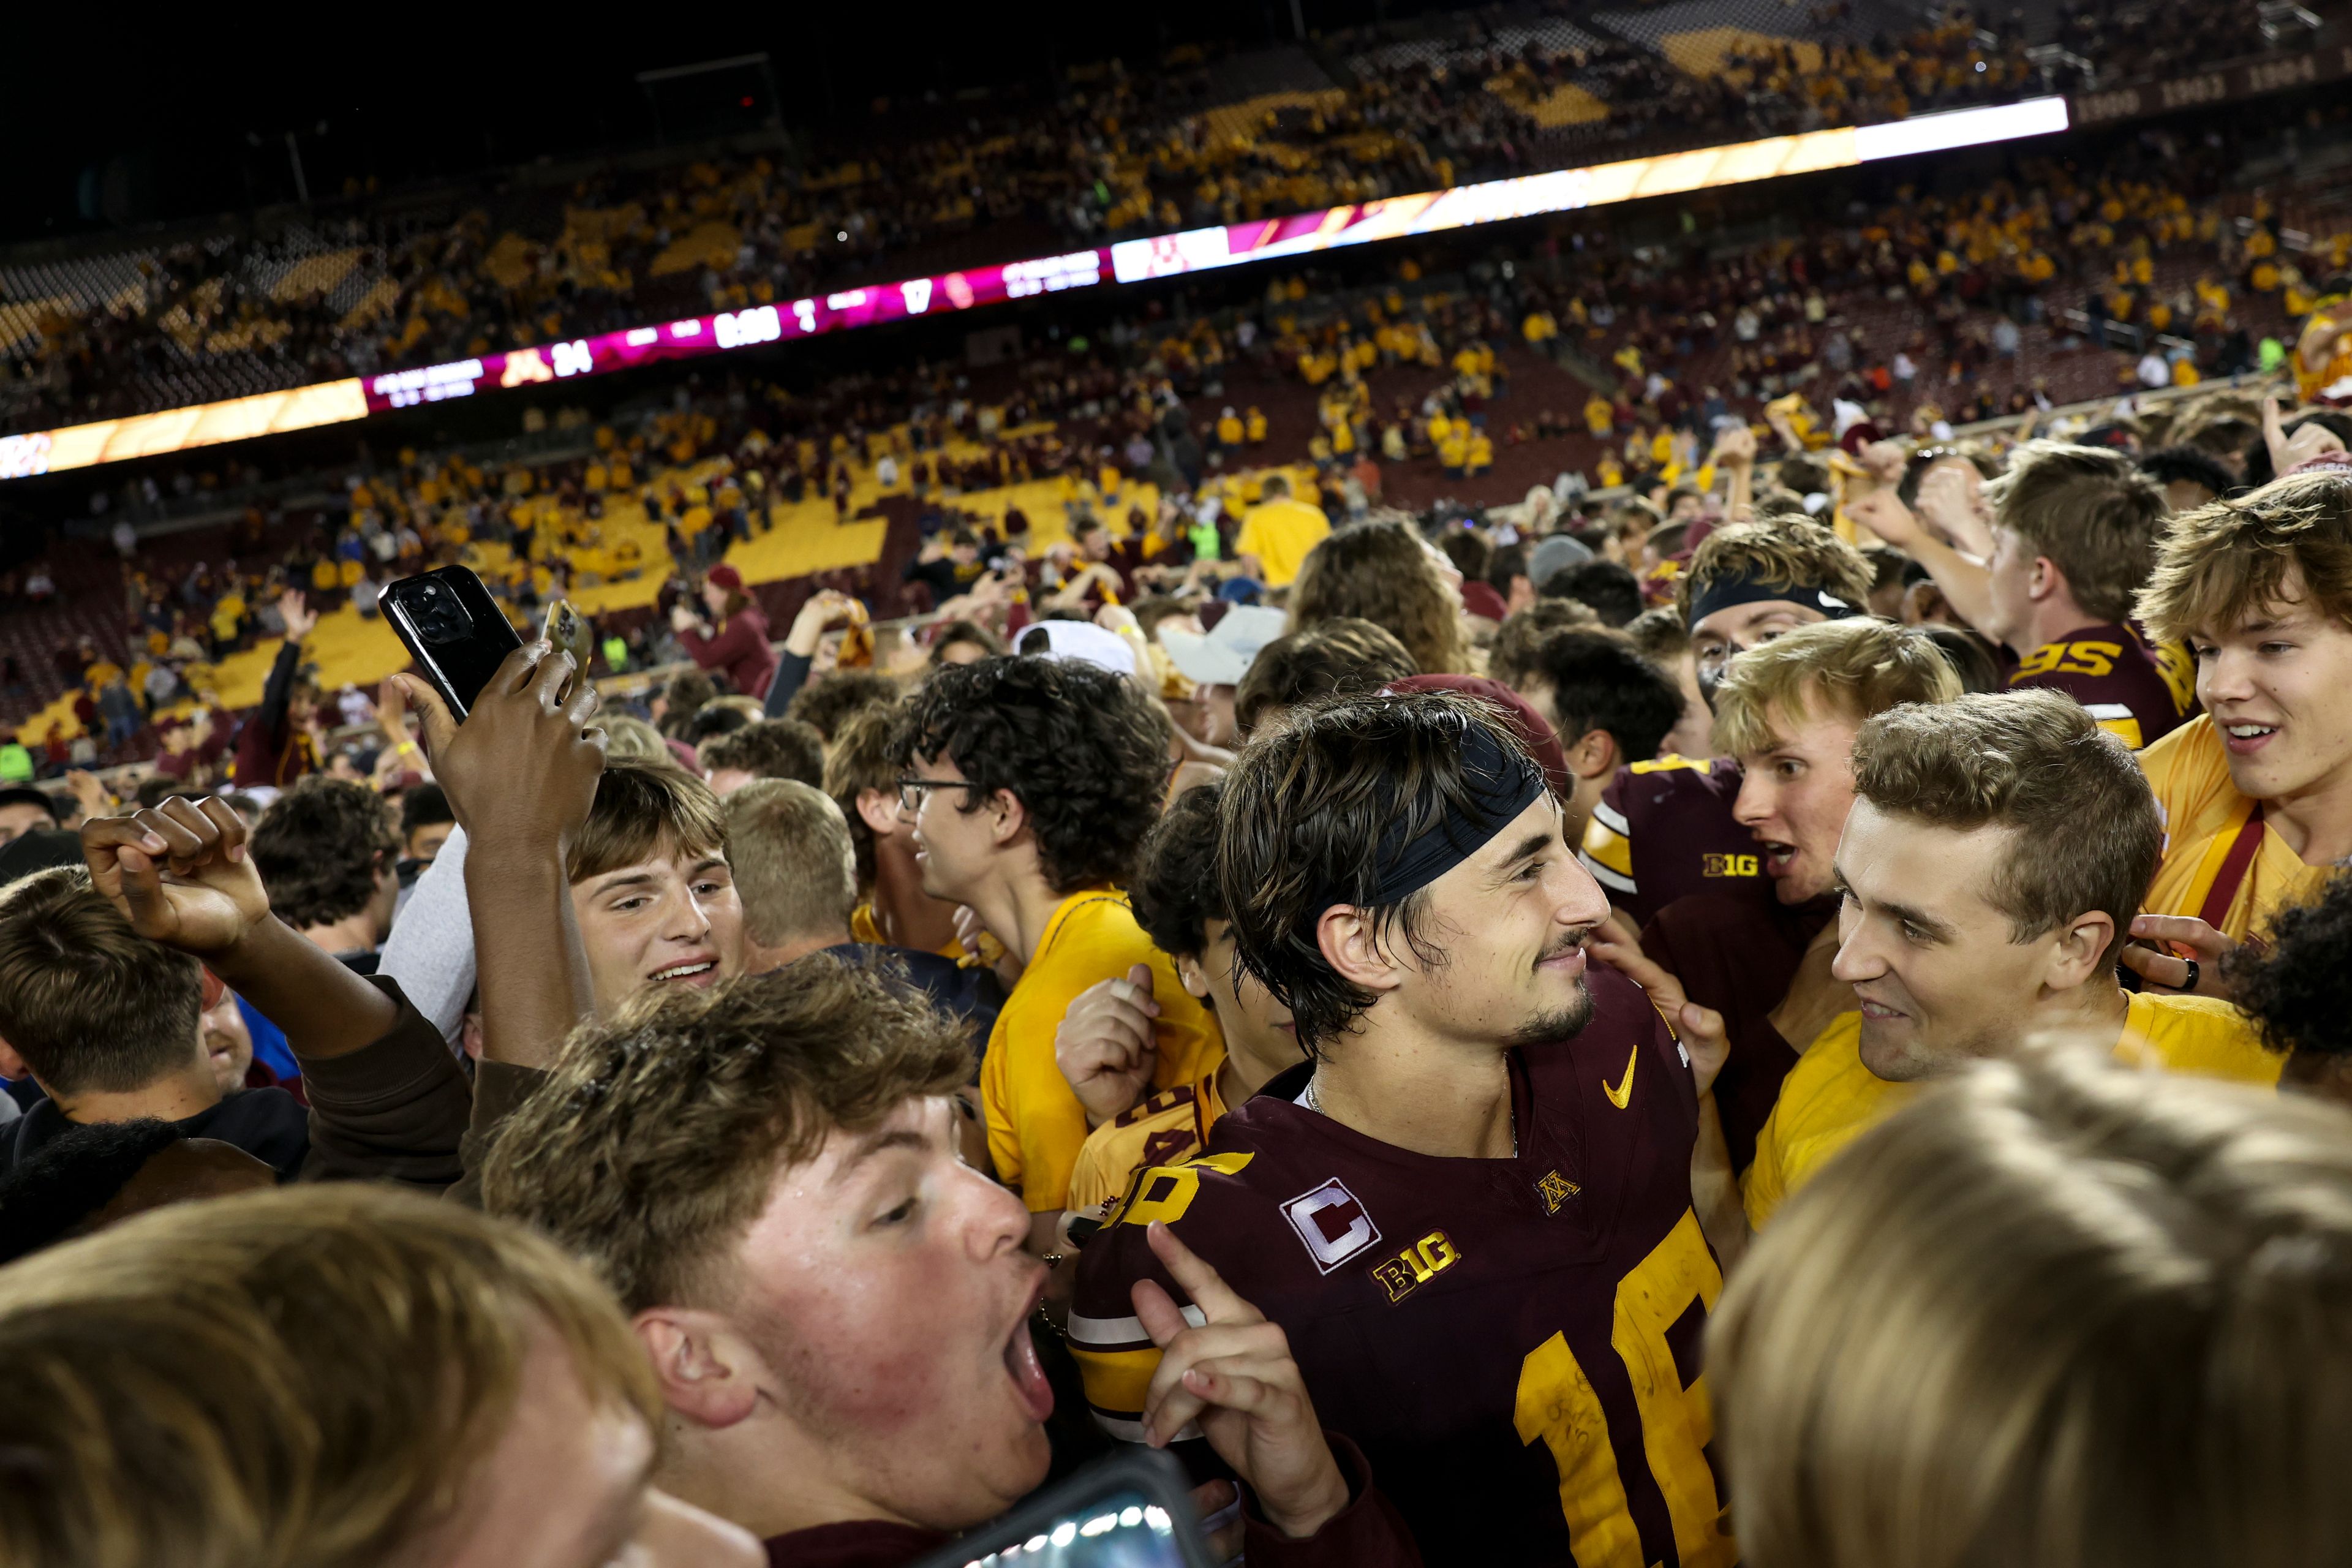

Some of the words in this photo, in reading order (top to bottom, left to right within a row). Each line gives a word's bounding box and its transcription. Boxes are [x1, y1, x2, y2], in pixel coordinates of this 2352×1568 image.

[2009, 640, 2124, 685] 95
[1537, 1170, 1580, 1213] M
[1291, 1186, 1371, 1264] C
